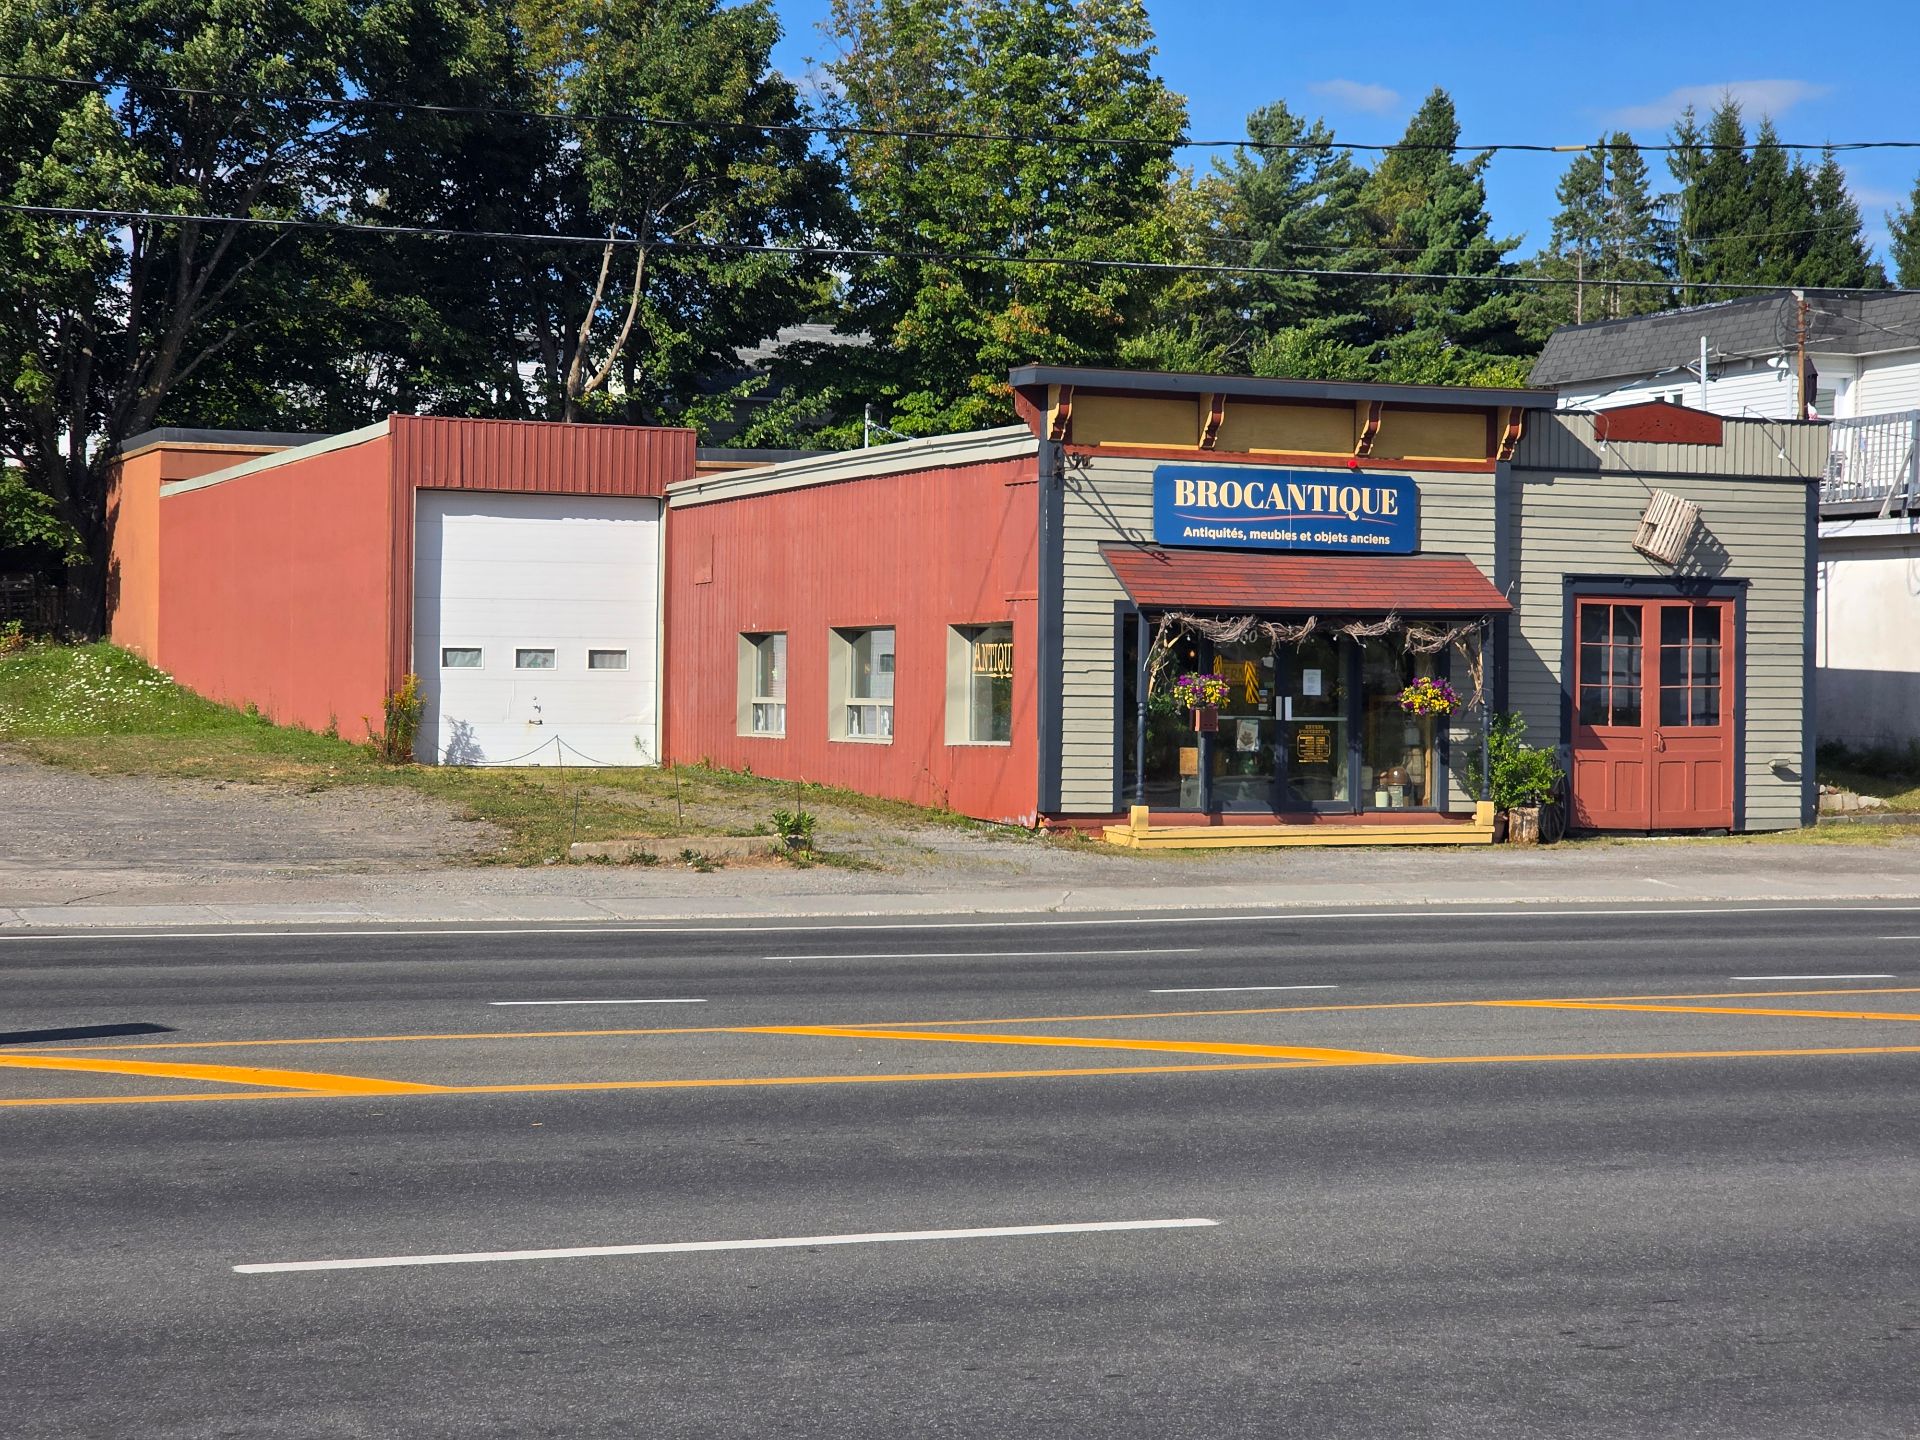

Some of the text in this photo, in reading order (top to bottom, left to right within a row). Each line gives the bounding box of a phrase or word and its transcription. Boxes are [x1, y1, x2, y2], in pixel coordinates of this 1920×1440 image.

[1174, 479, 1397, 521] BROCANTIQUE
[1183, 526, 1390, 545] Antiquités, meubles et objets anciens
[972, 643, 1013, 672] ANTIQU
